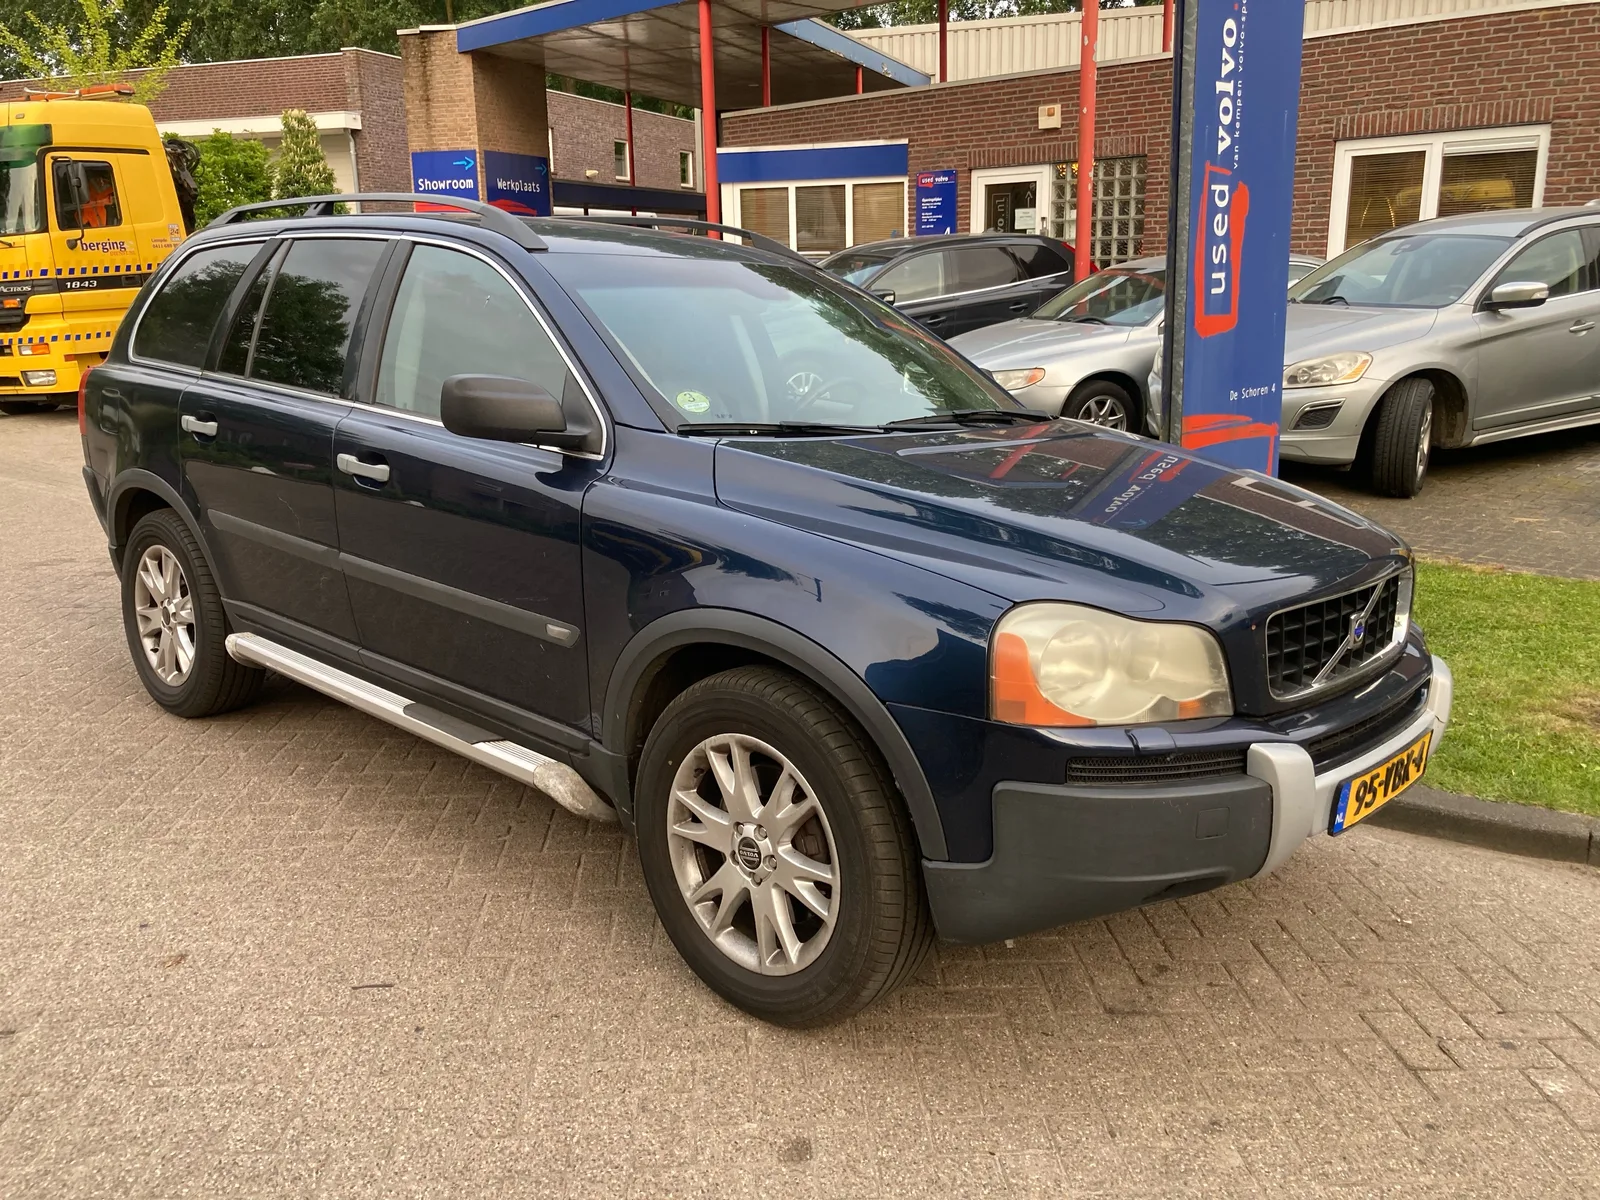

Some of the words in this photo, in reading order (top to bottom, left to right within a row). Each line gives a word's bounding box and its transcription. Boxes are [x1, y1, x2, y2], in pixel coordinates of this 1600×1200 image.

[1234, 80, 1243, 138] kempen
[418, 178, 474, 191] Showroom
[496, 178, 540, 193] Werkplaats
[169, 228, 179, 236] 24
[80, 238, 126, 253] berging
[1211, 184, 1229, 294] used
[65, 280, 97, 288] 1843
[683, 392, 696, 402] 3
[1229, 390, 1238, 401] De
[1241, 385, 1268, 399] Schoren
[1271, 383, 1276, 393] 4
[1334, 812, 1344, 825] NL
[739, 850, 759, 858] VOLVO
